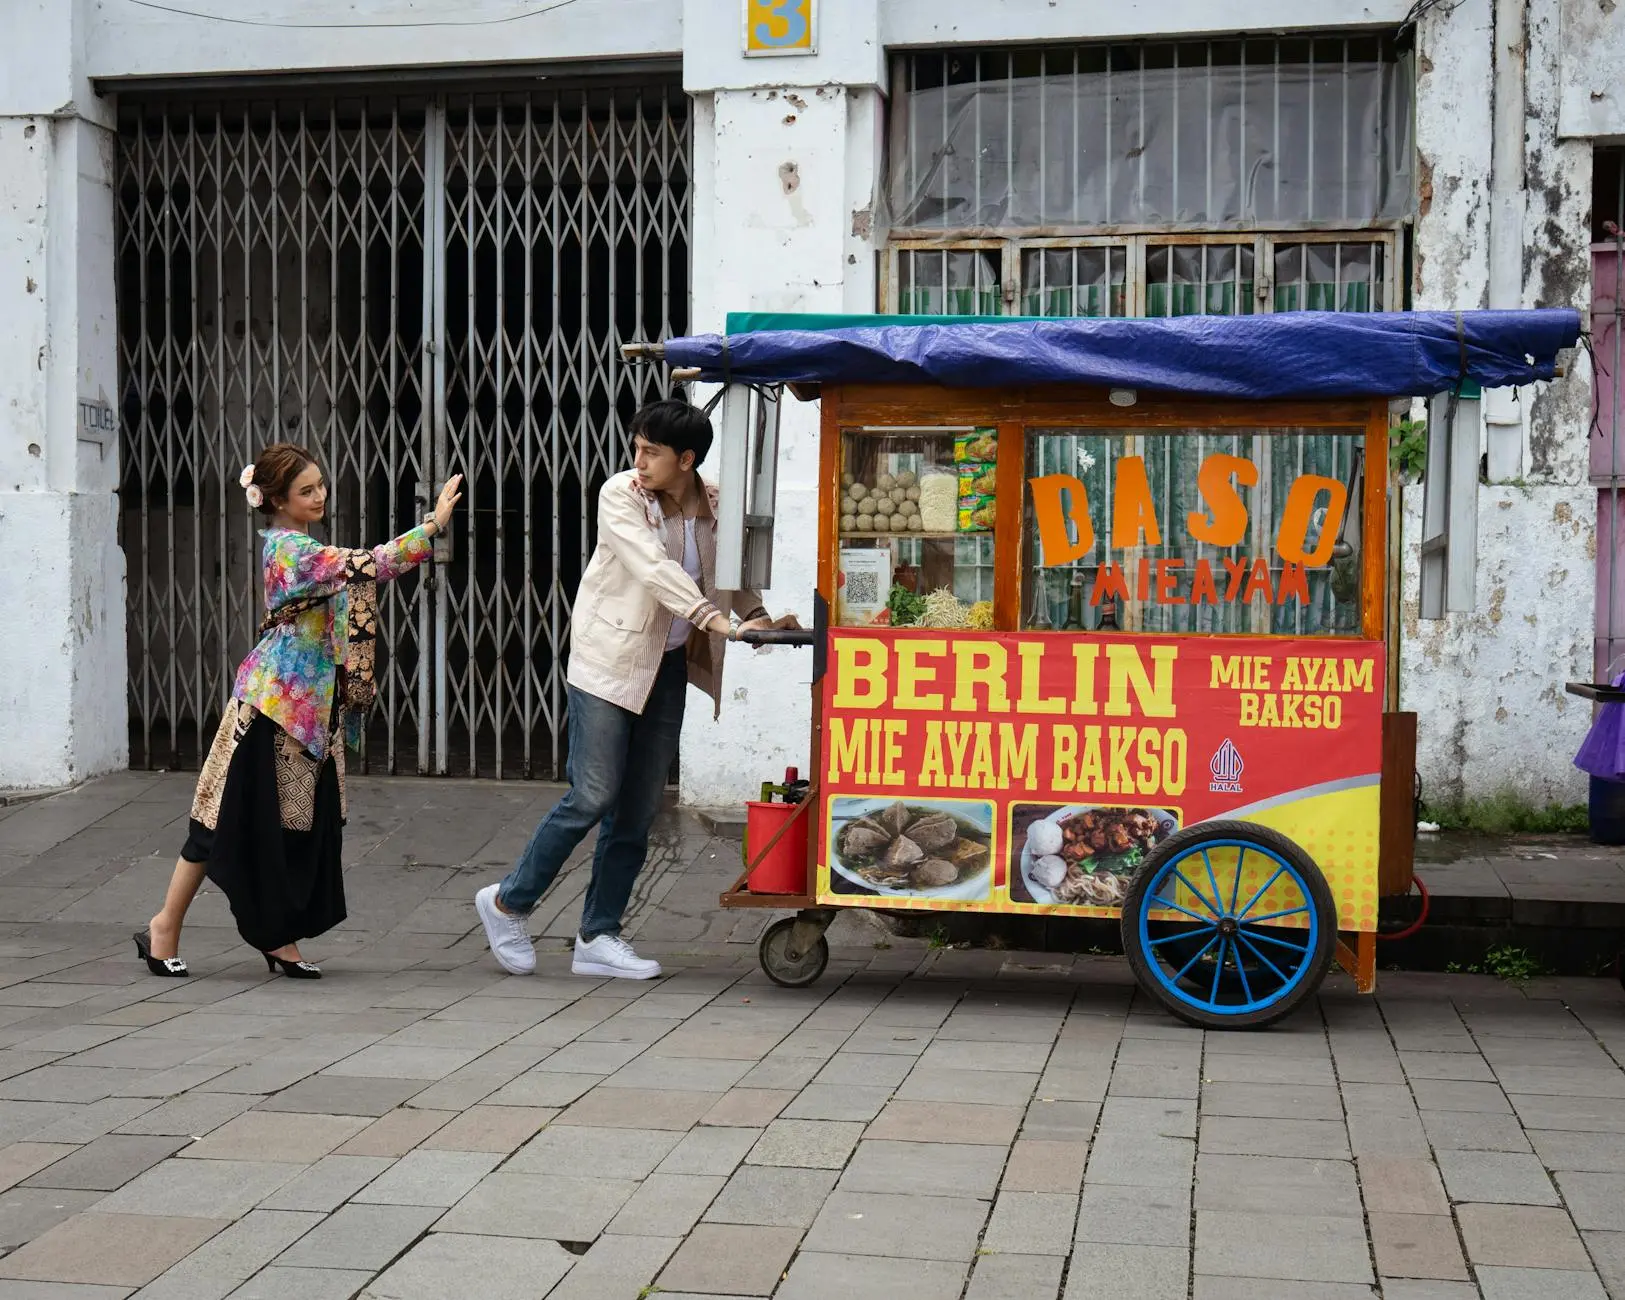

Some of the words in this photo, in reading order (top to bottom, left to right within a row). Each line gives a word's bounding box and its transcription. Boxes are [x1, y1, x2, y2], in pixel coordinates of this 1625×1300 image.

[755, 0, 806, 46] 3
[833, 637, 1178, 718] BERLIN
[1209, 655, 1272, 690] MIE
[1280, 657, 1375, 693] AYAM
[1239, 693, 1342, 729] BAKSO
[828, 717, 907, 786] MIE
[918, 720, 1039, 790] AYAM
[1051, 724, 1187, 796] BAKSO
[1210, 783, 1243, 792] HALAL
